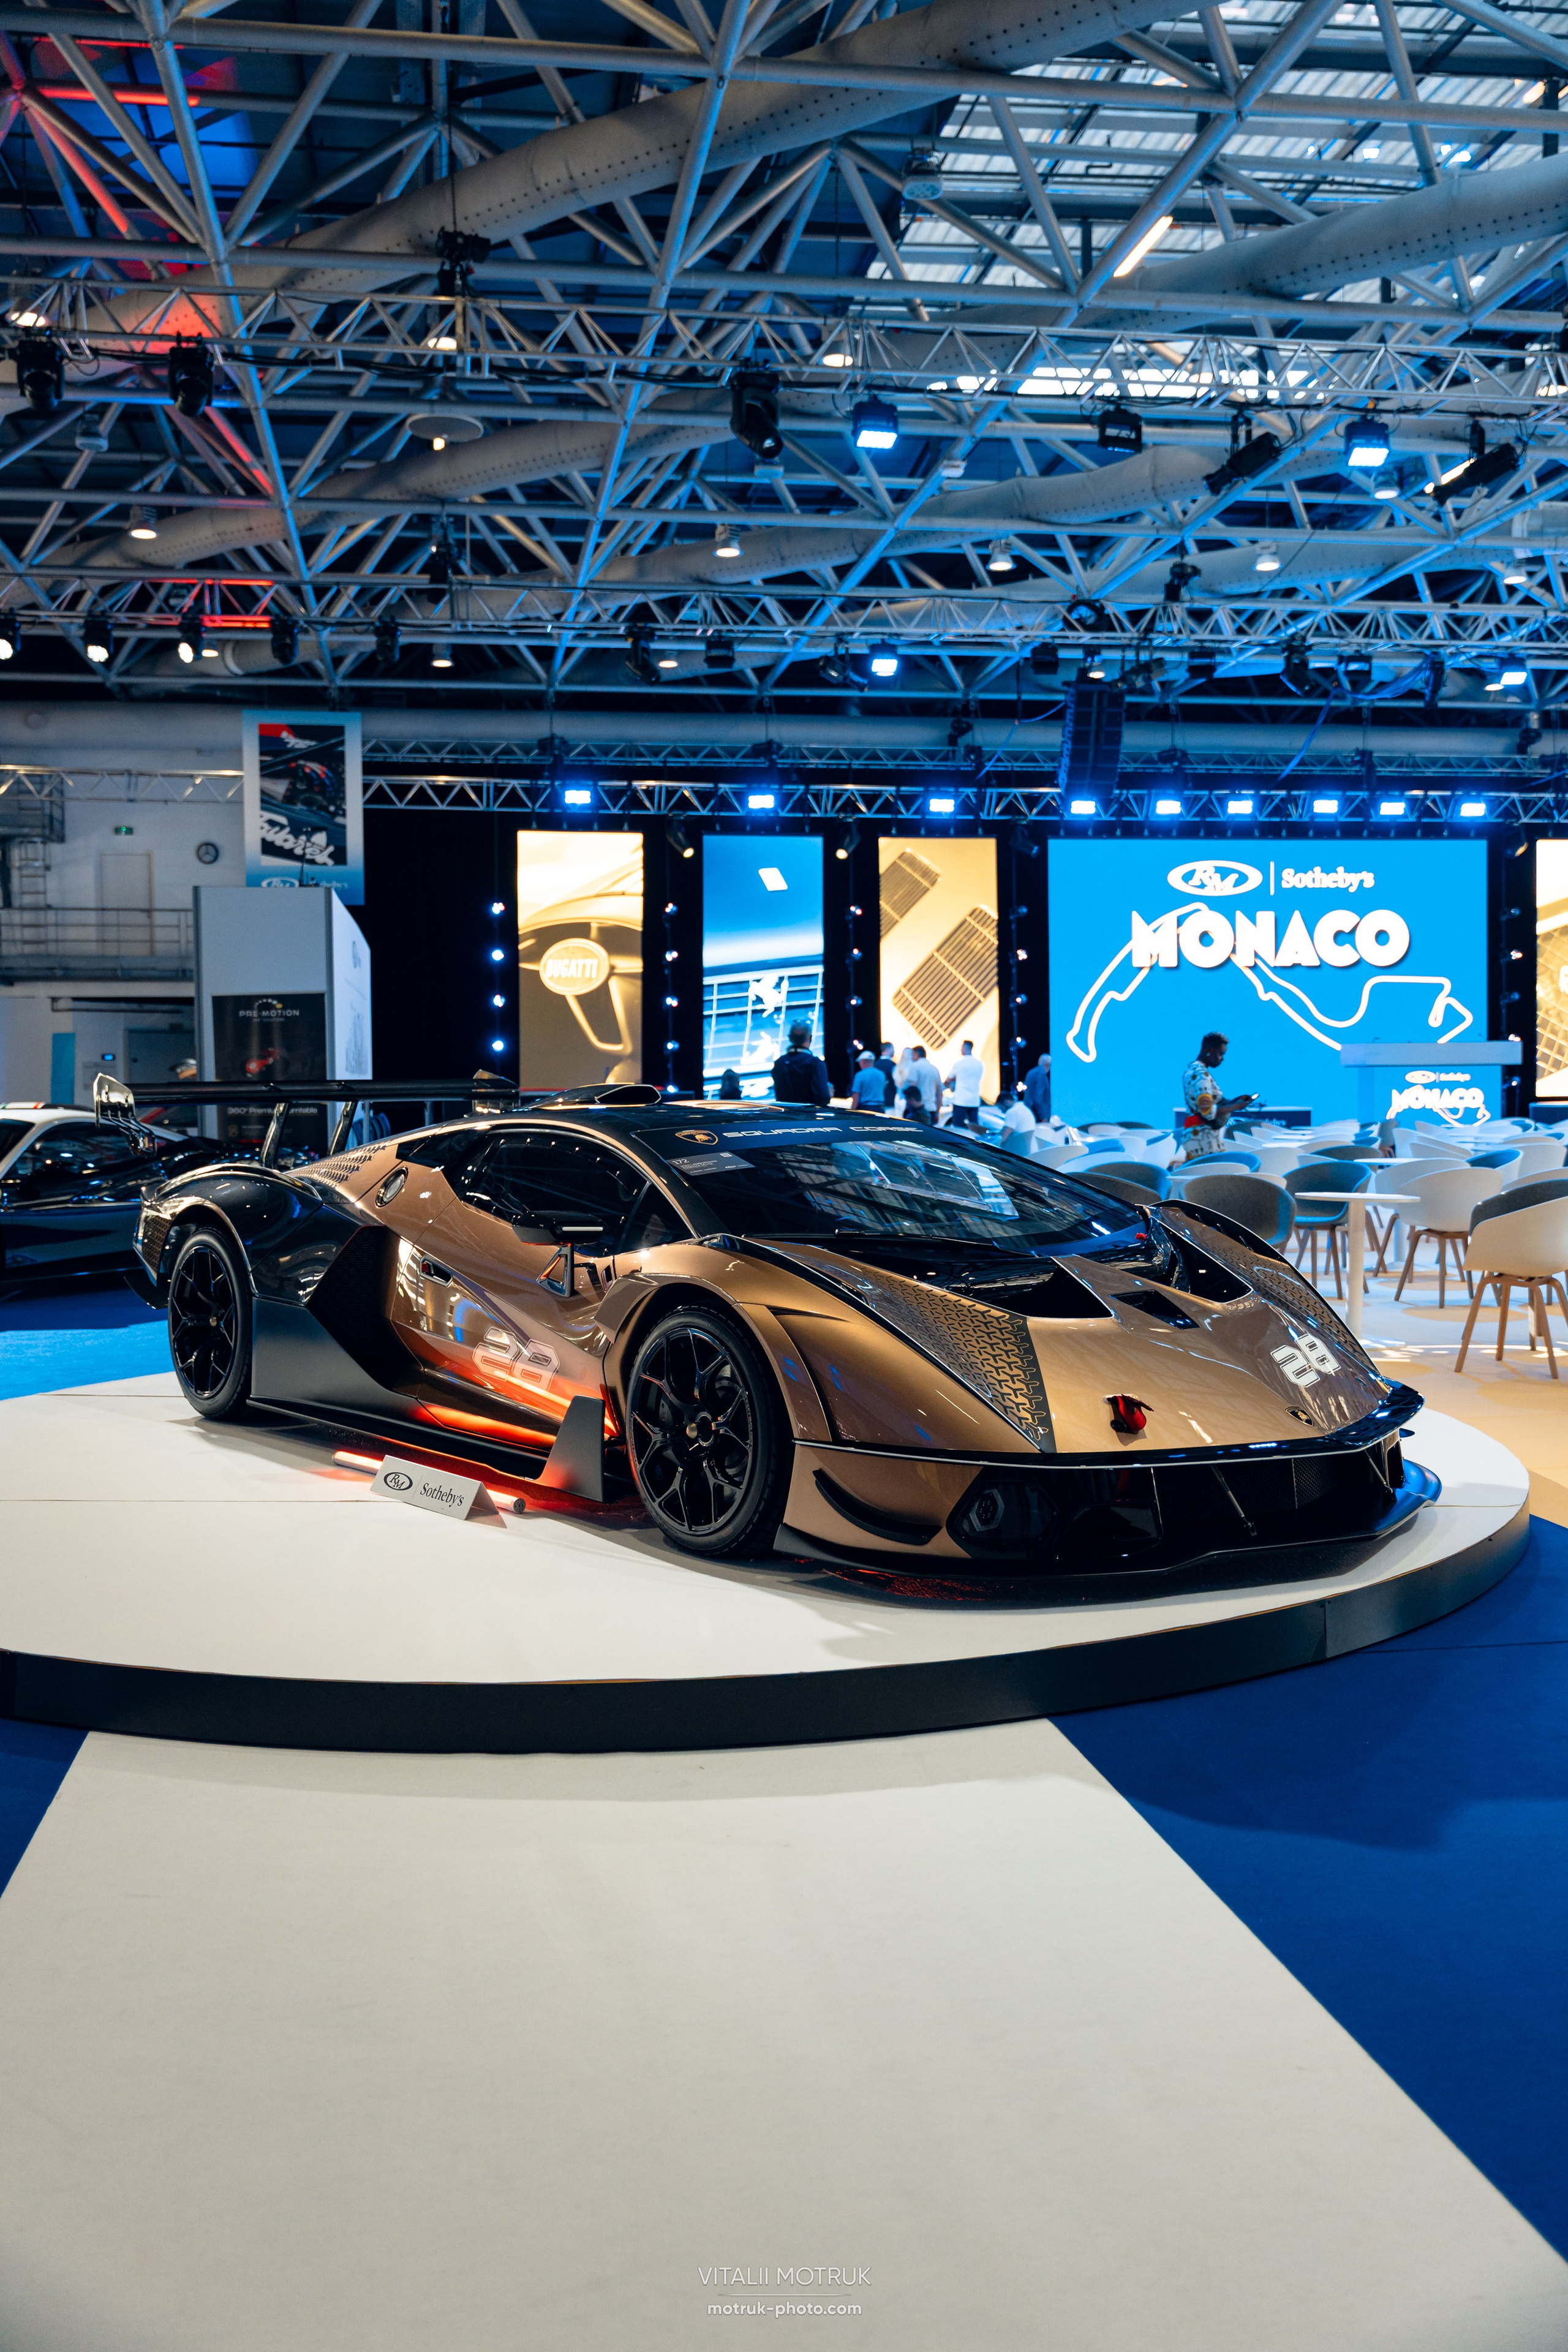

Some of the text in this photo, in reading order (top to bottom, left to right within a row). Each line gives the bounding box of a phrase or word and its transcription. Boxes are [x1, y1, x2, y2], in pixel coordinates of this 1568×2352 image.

[1281, 866, 1375, 893] Sotheby's
[1131, 909, 1410, 968] MONACO
[546, 958, 598, 978] BUGATTI
[1392, 1087, 1485, 1109] MONACO
[723, 1127, 842, 1137] SQUADRA
[472, 1326, 560, 1392] 28
[1270, 1333, 1341, 1388] 28
[390, 1474, 464, 1507] RM Sotheby's
